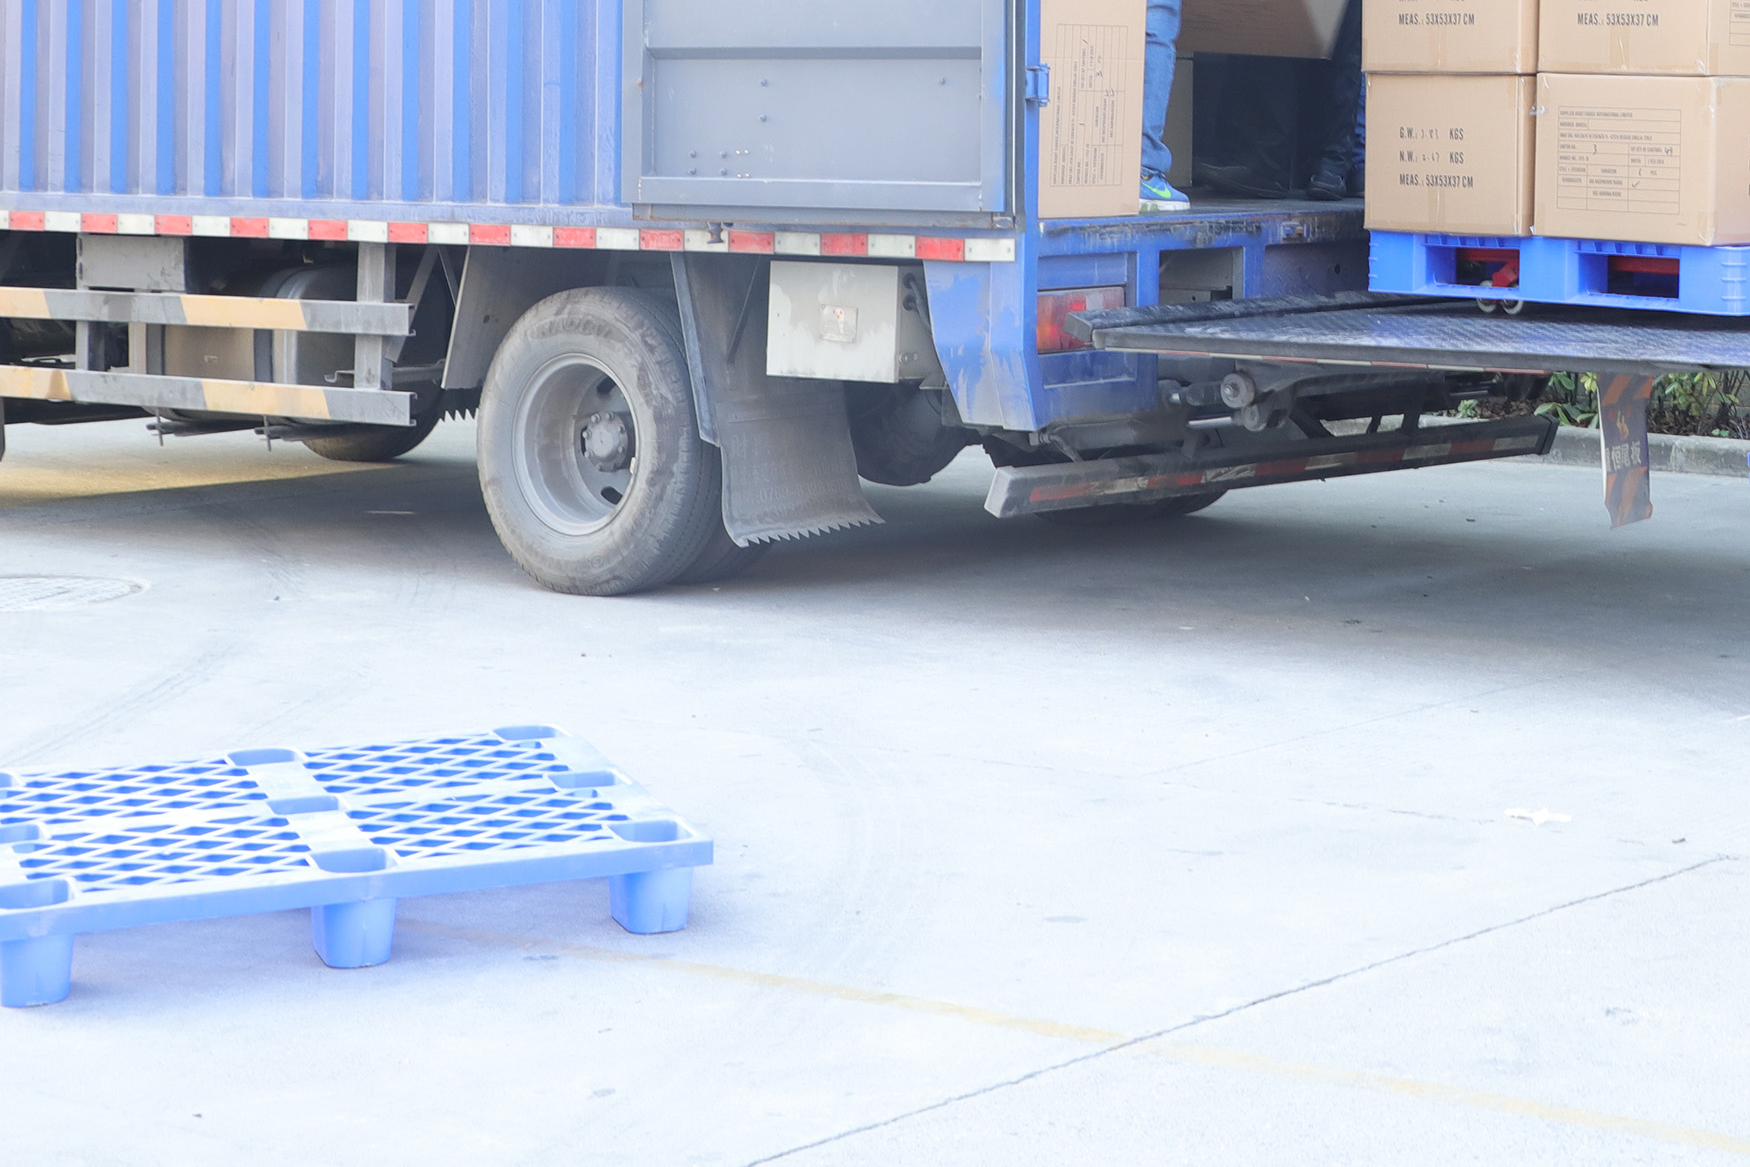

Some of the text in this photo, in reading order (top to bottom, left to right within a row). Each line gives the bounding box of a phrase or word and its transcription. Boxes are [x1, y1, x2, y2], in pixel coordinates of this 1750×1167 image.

[1399, 13, 1474, 26] MEAS.: 53X53X37 CM
[1578, 13, 1658, 26] MEAS.: 53X53X37 CM
[1400, 127, 1417, 139] G.W.:
[1450, 128, 1463, 140] KGS
[1400, 150, 1417, 162] N.W.:
[1450, 152, 1463, 164] KGS
[1400, 174, 1473, 188] MEAS.: 53X53X37 CM
